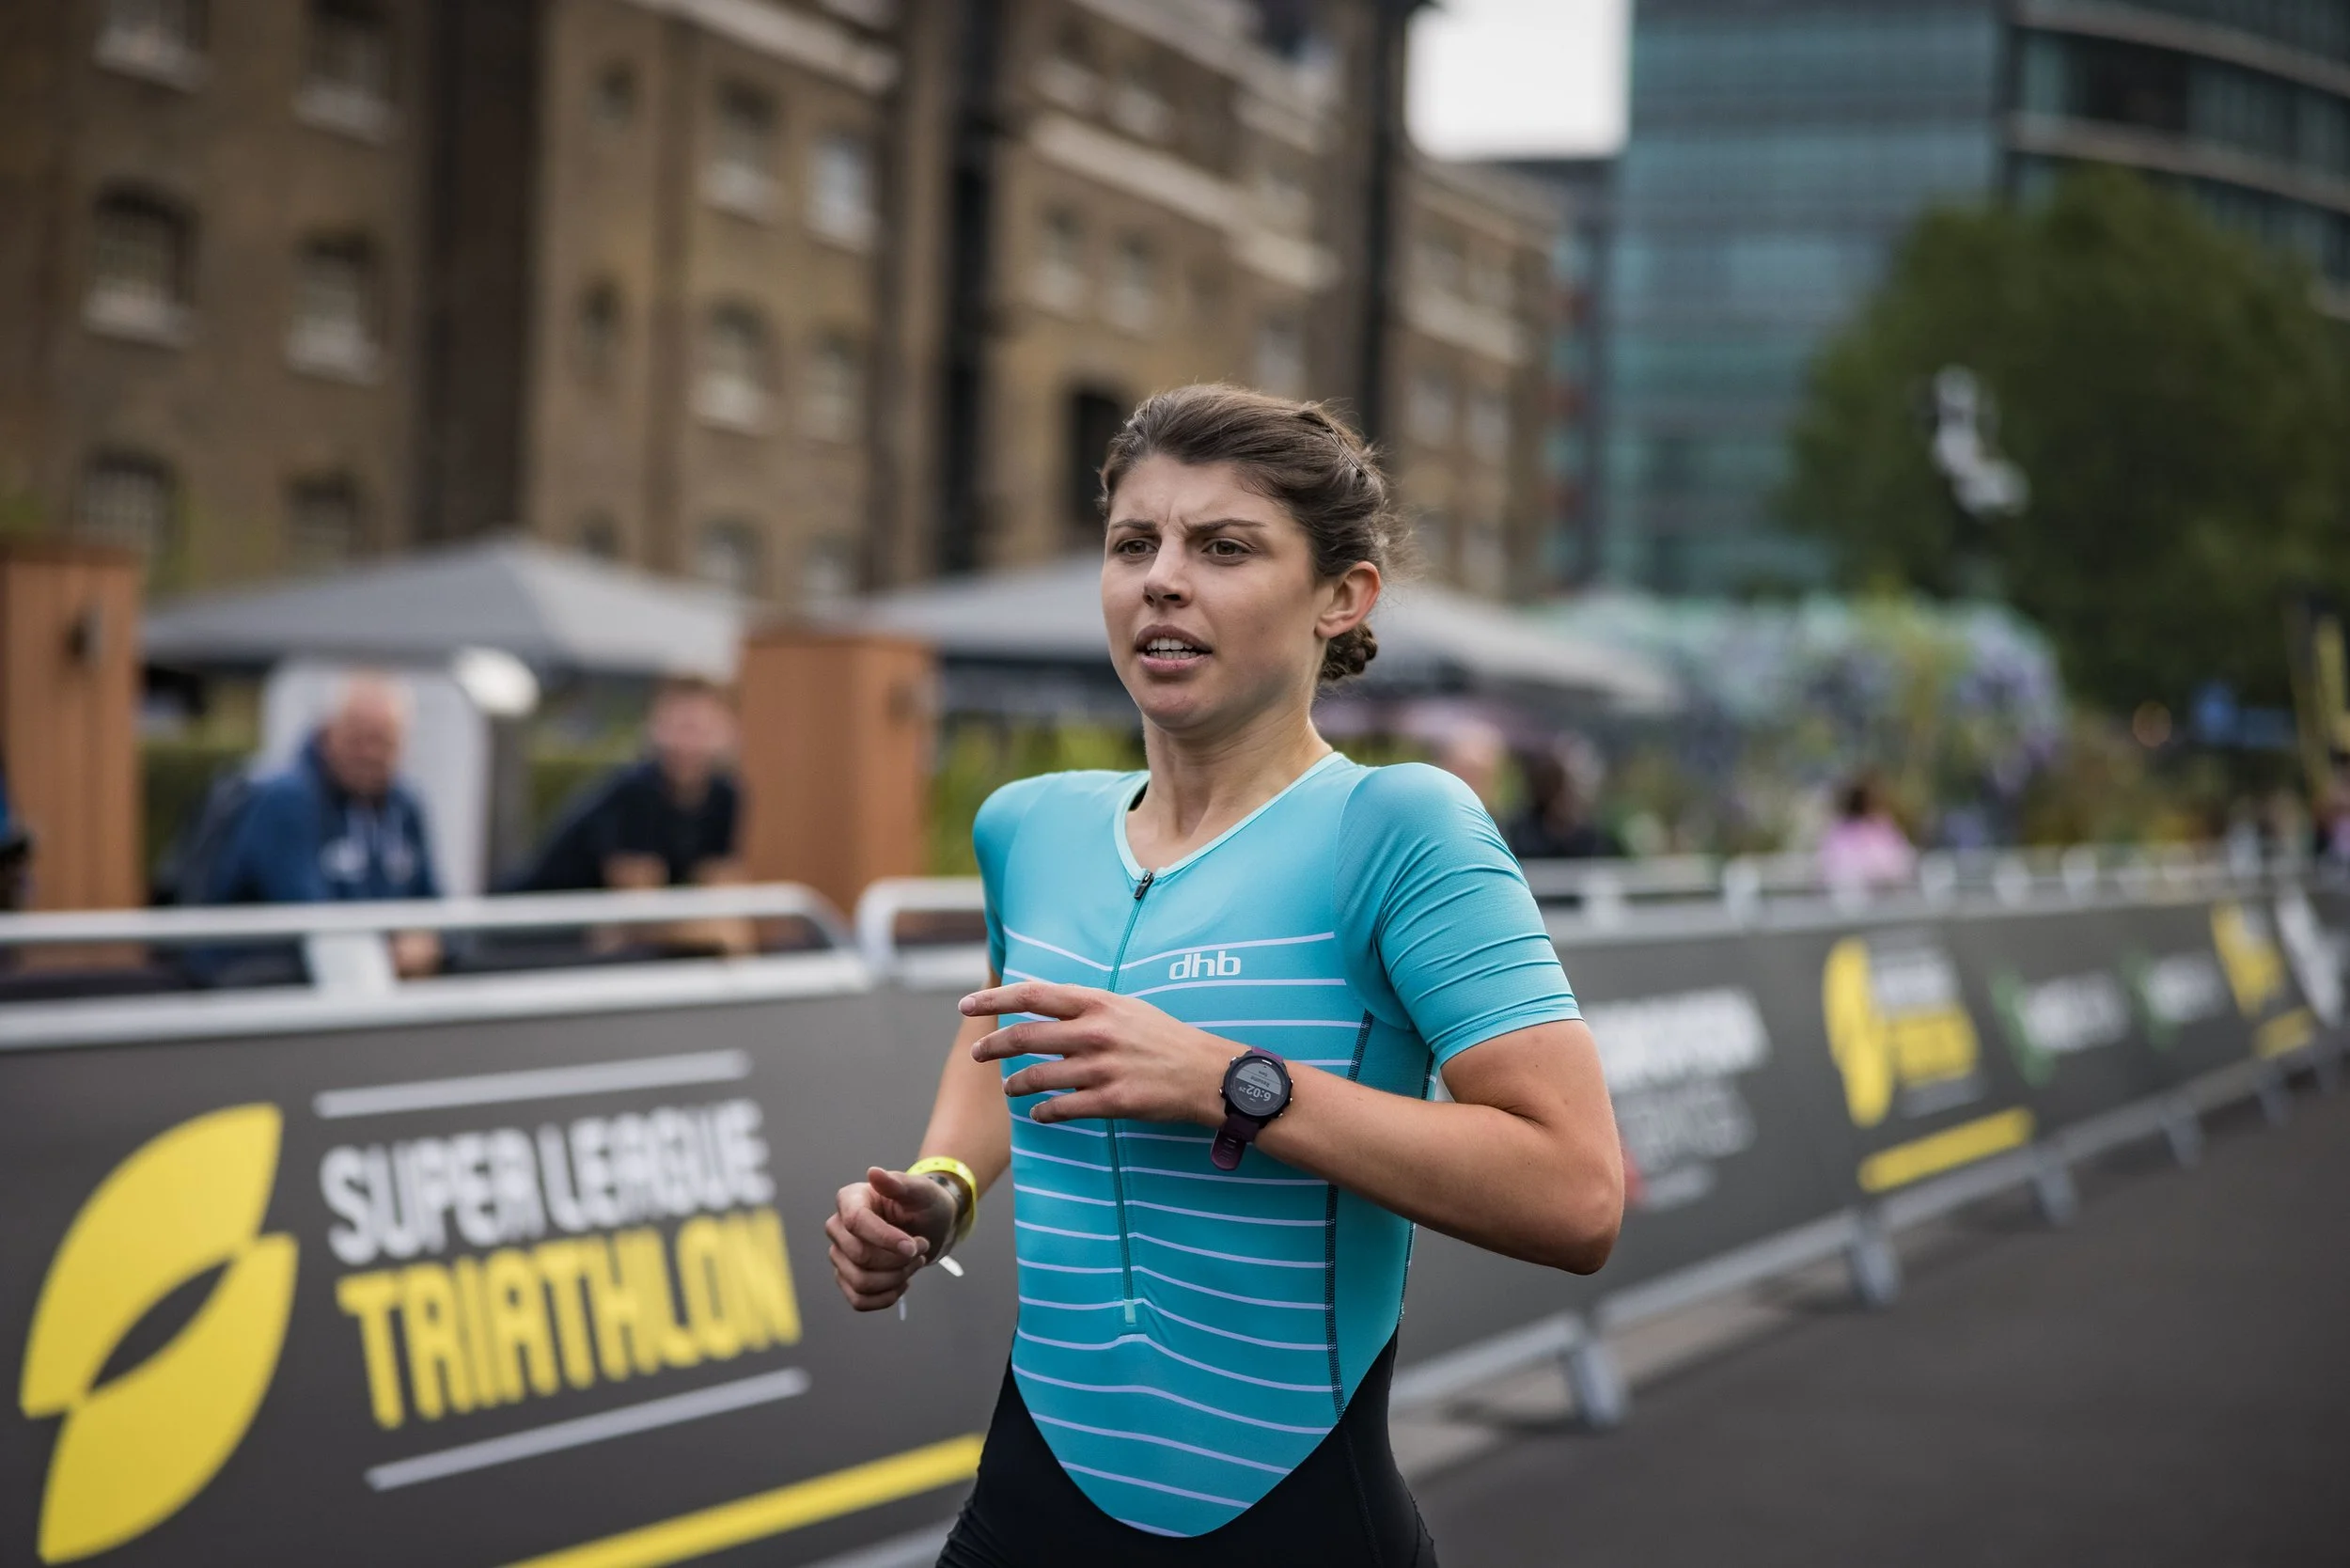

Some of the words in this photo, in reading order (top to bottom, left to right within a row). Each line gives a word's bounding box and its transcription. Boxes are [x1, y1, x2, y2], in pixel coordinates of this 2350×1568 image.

[1168, 950, 1241, 980] dhb
[1246, 1084, 1271, 1102] 6:02
[320, 1127, 546, 1266] SUPER
[540, 1098, 777, 1233] LEAGUE
[336, 1209, 802, 1429] TRIATHLON
